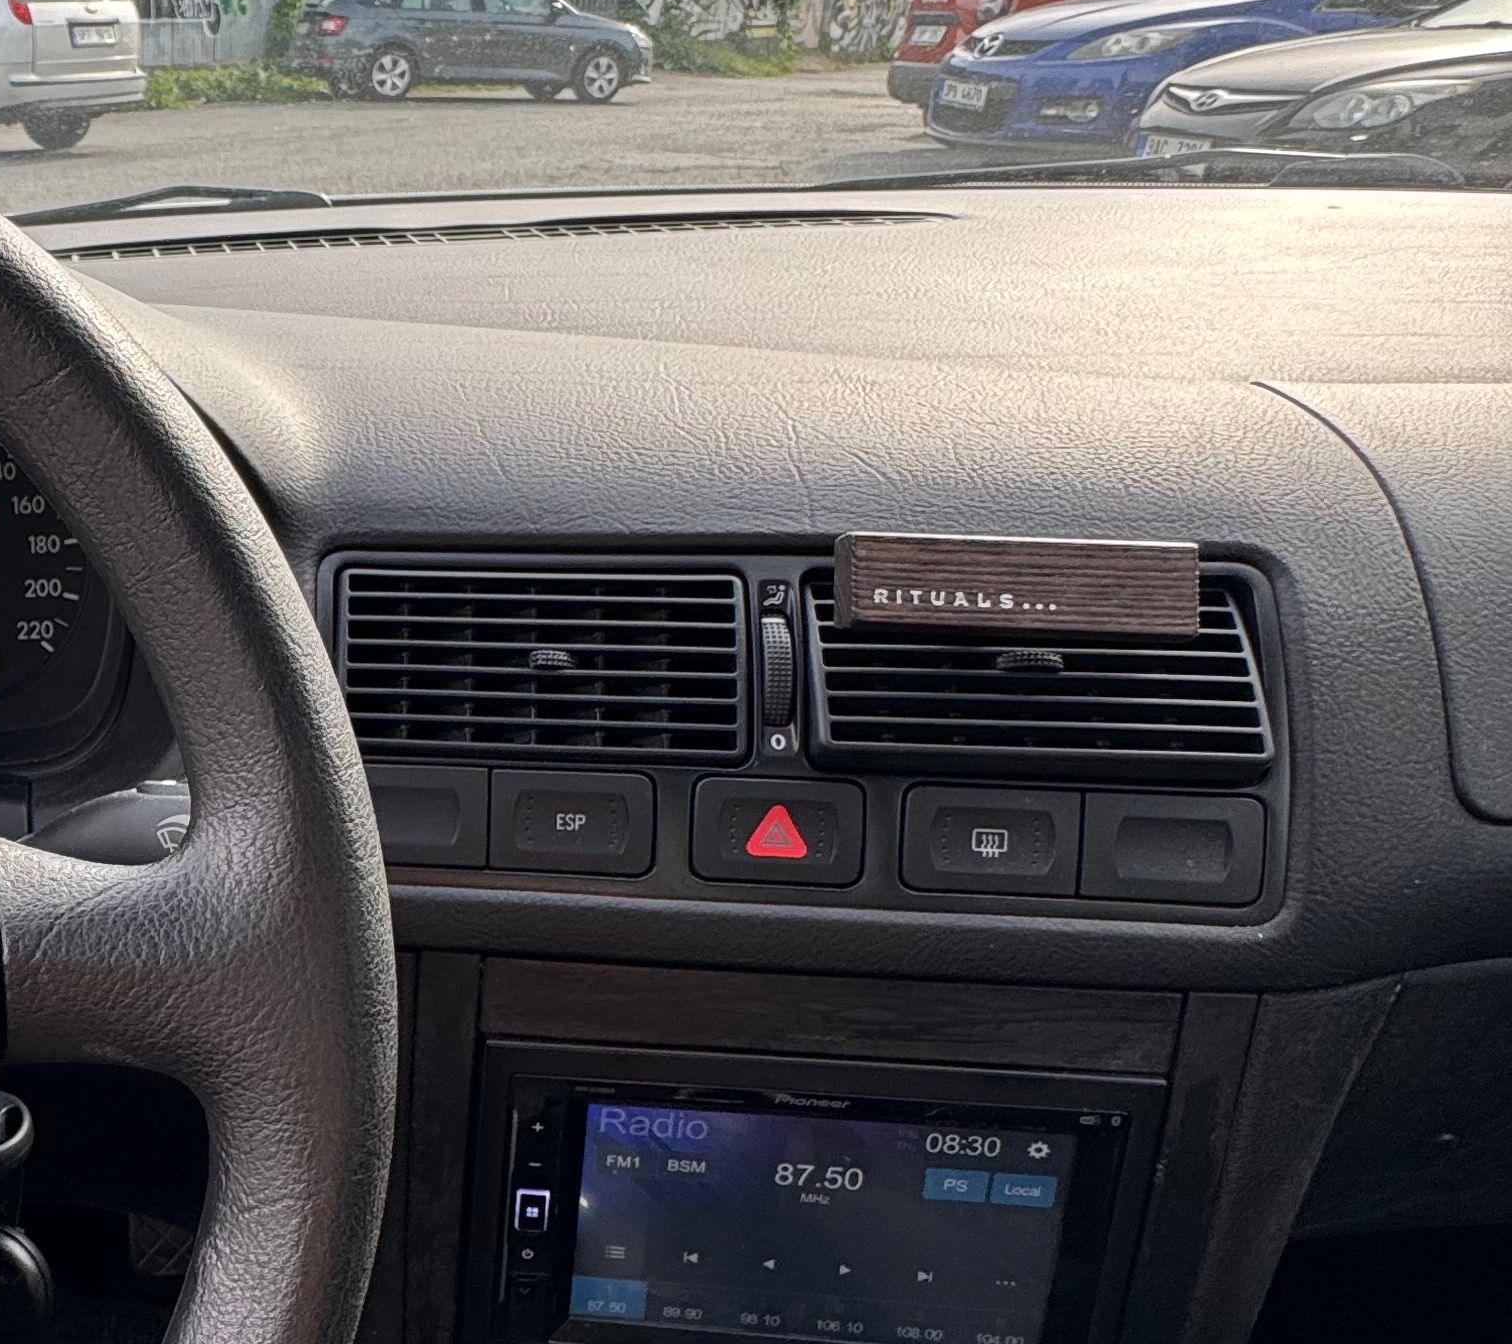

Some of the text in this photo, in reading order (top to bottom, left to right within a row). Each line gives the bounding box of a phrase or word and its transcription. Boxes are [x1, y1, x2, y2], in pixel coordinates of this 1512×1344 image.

[11, 495, 45, 514] 160
[28, 534, 61, 554] 180
[24, 578, 62, 598] 200
[16, 620, 54, 640] 220
[555, 812, 586, 832] ESP
[598, 1106, 709, 1140] Radio
[925, 1132, 1002, 1158] 08:30
[605, 1154, 707, 1174] FM1 BSM
[774, 1161, 865, 1191] 87.50
[799, 1191, 832, 1206] MHz
[943, 1178, 1043, 1199] PS Local
